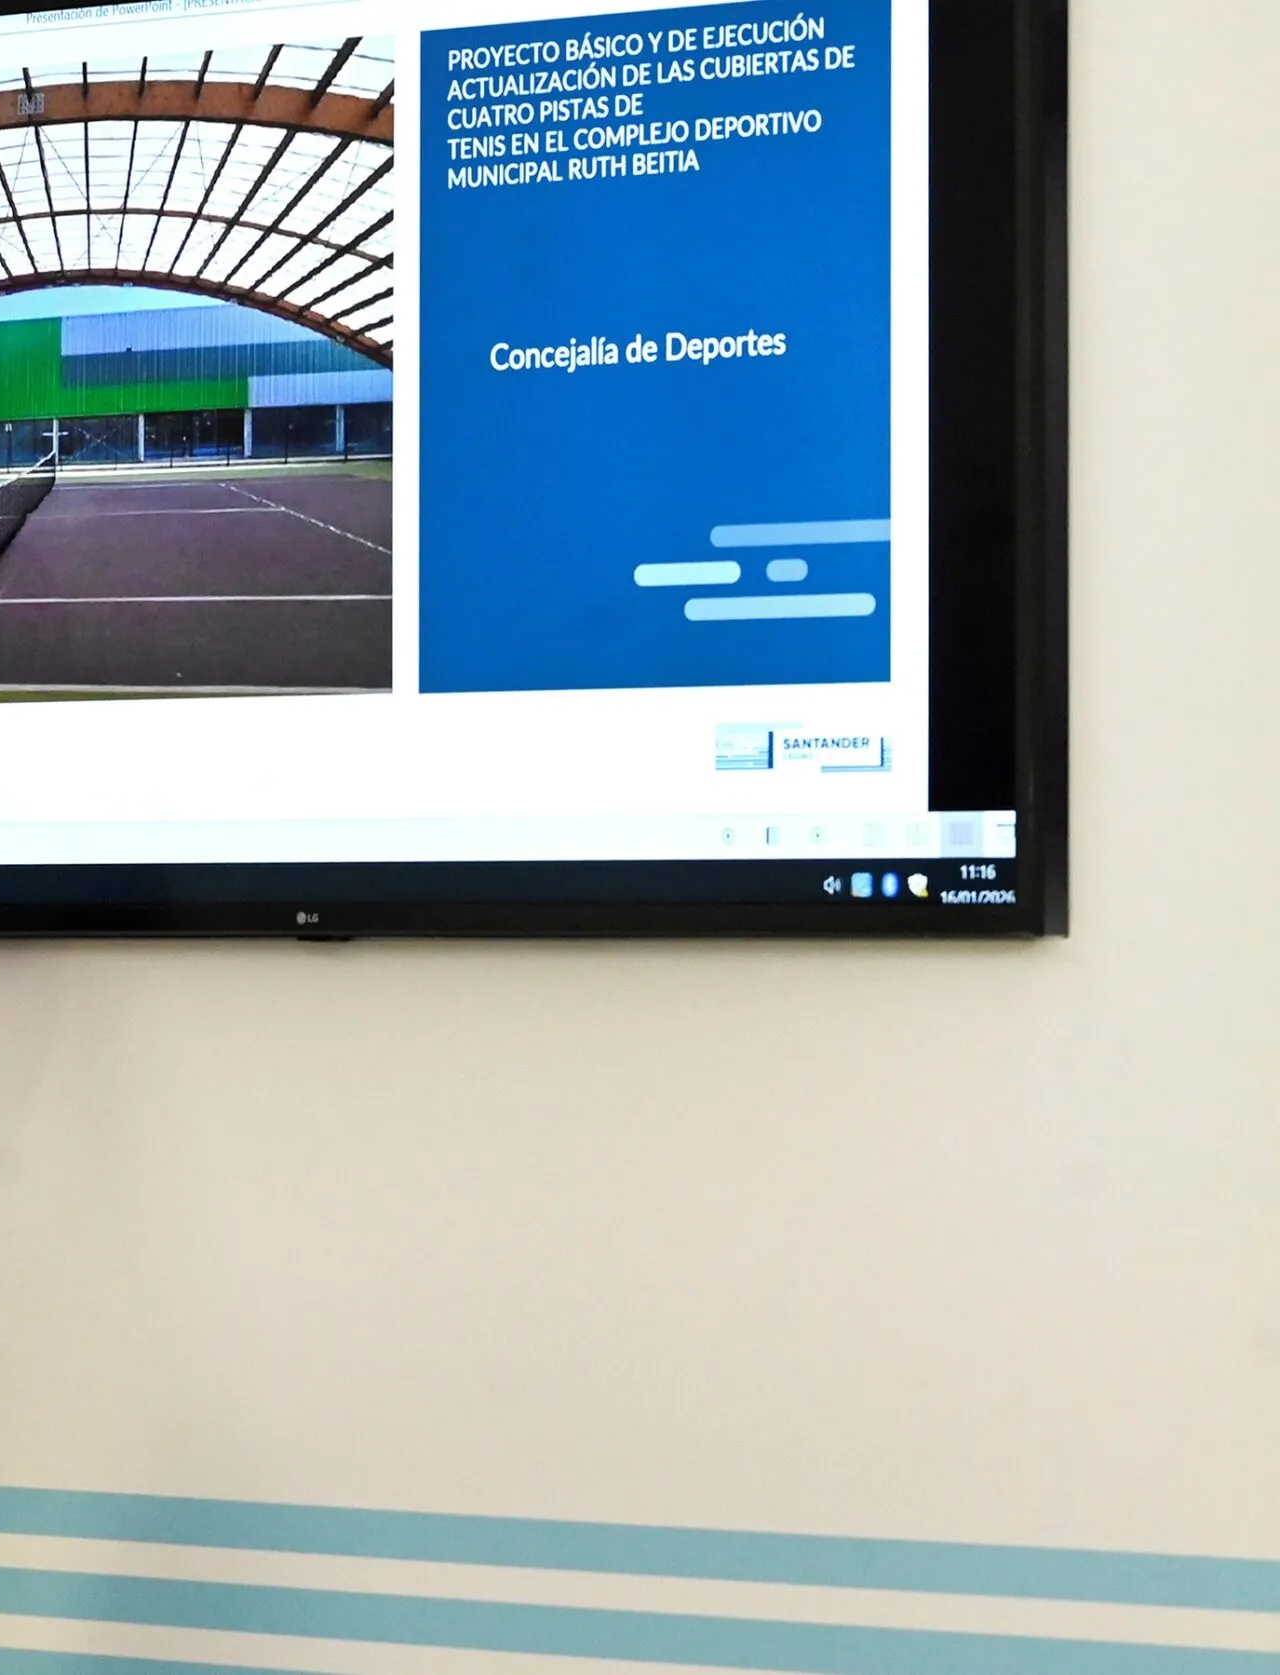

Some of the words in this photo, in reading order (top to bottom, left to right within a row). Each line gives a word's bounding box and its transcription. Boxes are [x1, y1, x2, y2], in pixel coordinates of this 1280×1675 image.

[26, 8, 92, 24] Presentación
[96, 6, 109, 18] de
[113, 2, 172, 16] PowerPoint
[449, 41, 560, 71] PROYECTO
[566, 32, 643, 61] BÁSICO
[648, 32, 663, 54] Y
[669, 28, 697, 52] DE
[703, 12, 825, 49] EJECUCIÓN
[447, 62, 616, 102] ACTUALIZACIÓN
[623, 63, 651, 87] DE
[657, 59, 695, 84] LAS
[700, 49, 819, 80] CUBIERTAS
[825, 45, 856, 70] DE
[447, 103, 534, 130] CUATRO
[540, 96, 609, 123] PISTAS
[615, 93, 644, 117] DE
[447, 135, 506, 160] TENIS
[511, 132, 539, 156] EN
[545, 130, 569, 153] EL
[573, 120, 689, 150] COMPLEJO
[695, 109, 822, 141] DEPORTIVO
[448, 160, 563, 189] MUNICIPAL
[569, 154, 626, 180] RUTH
[632, 149, 700, 175] BEITIA
[490, 336, 619, 373] Concejalía
[626, 334, 658, 363] de
[665, 329, 787, 365] Deportes
[783, 737, 870, 750] SANTANDER
[960, 864, 996, 880] 11:16
[940, 890, 1016, 904] 16/01/2026
